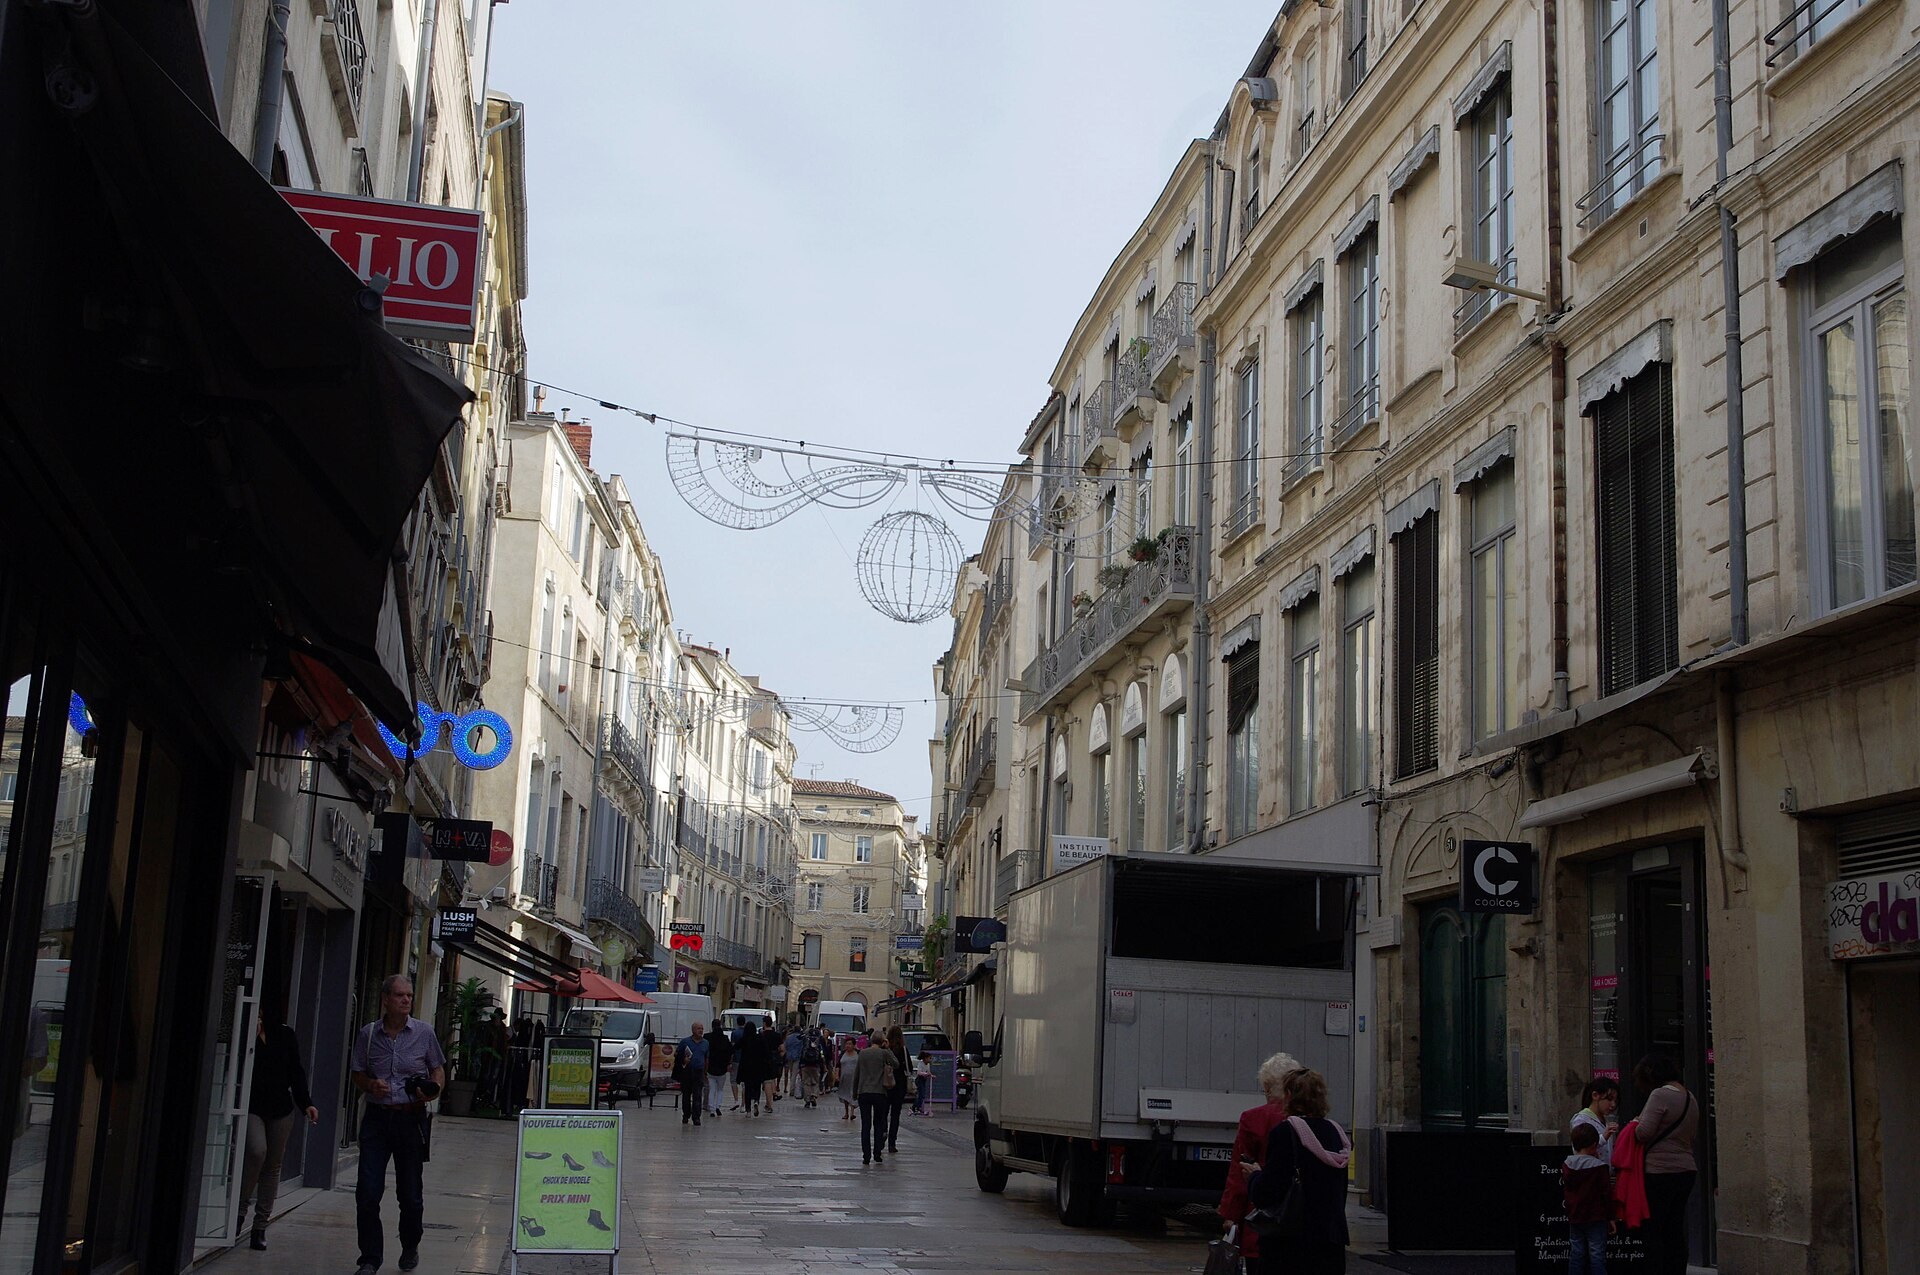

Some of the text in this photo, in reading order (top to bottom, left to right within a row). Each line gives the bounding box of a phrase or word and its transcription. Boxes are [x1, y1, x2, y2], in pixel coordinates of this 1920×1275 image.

[1059, 843, 1103, 852] INSTITUT
[1474, 898, 1521, 908] coolcos
[443, 911, 475, 922] LUSH
[671, 924, 703, 932] LANZONE
[551, 1055, 591, 1064] EXPRESS
[548, 1064, 593, 1083] 1H30
[567, 1120, 616, 1129] COLLECTION
[1540, 1164, 1559, 1175] Pose
[542, 1176, 591, 1184] CHOIX DE MODELE
[540, 1194, 591, 1204] PRIX MINI
[1540, 1213, 1545, 1222] 6
